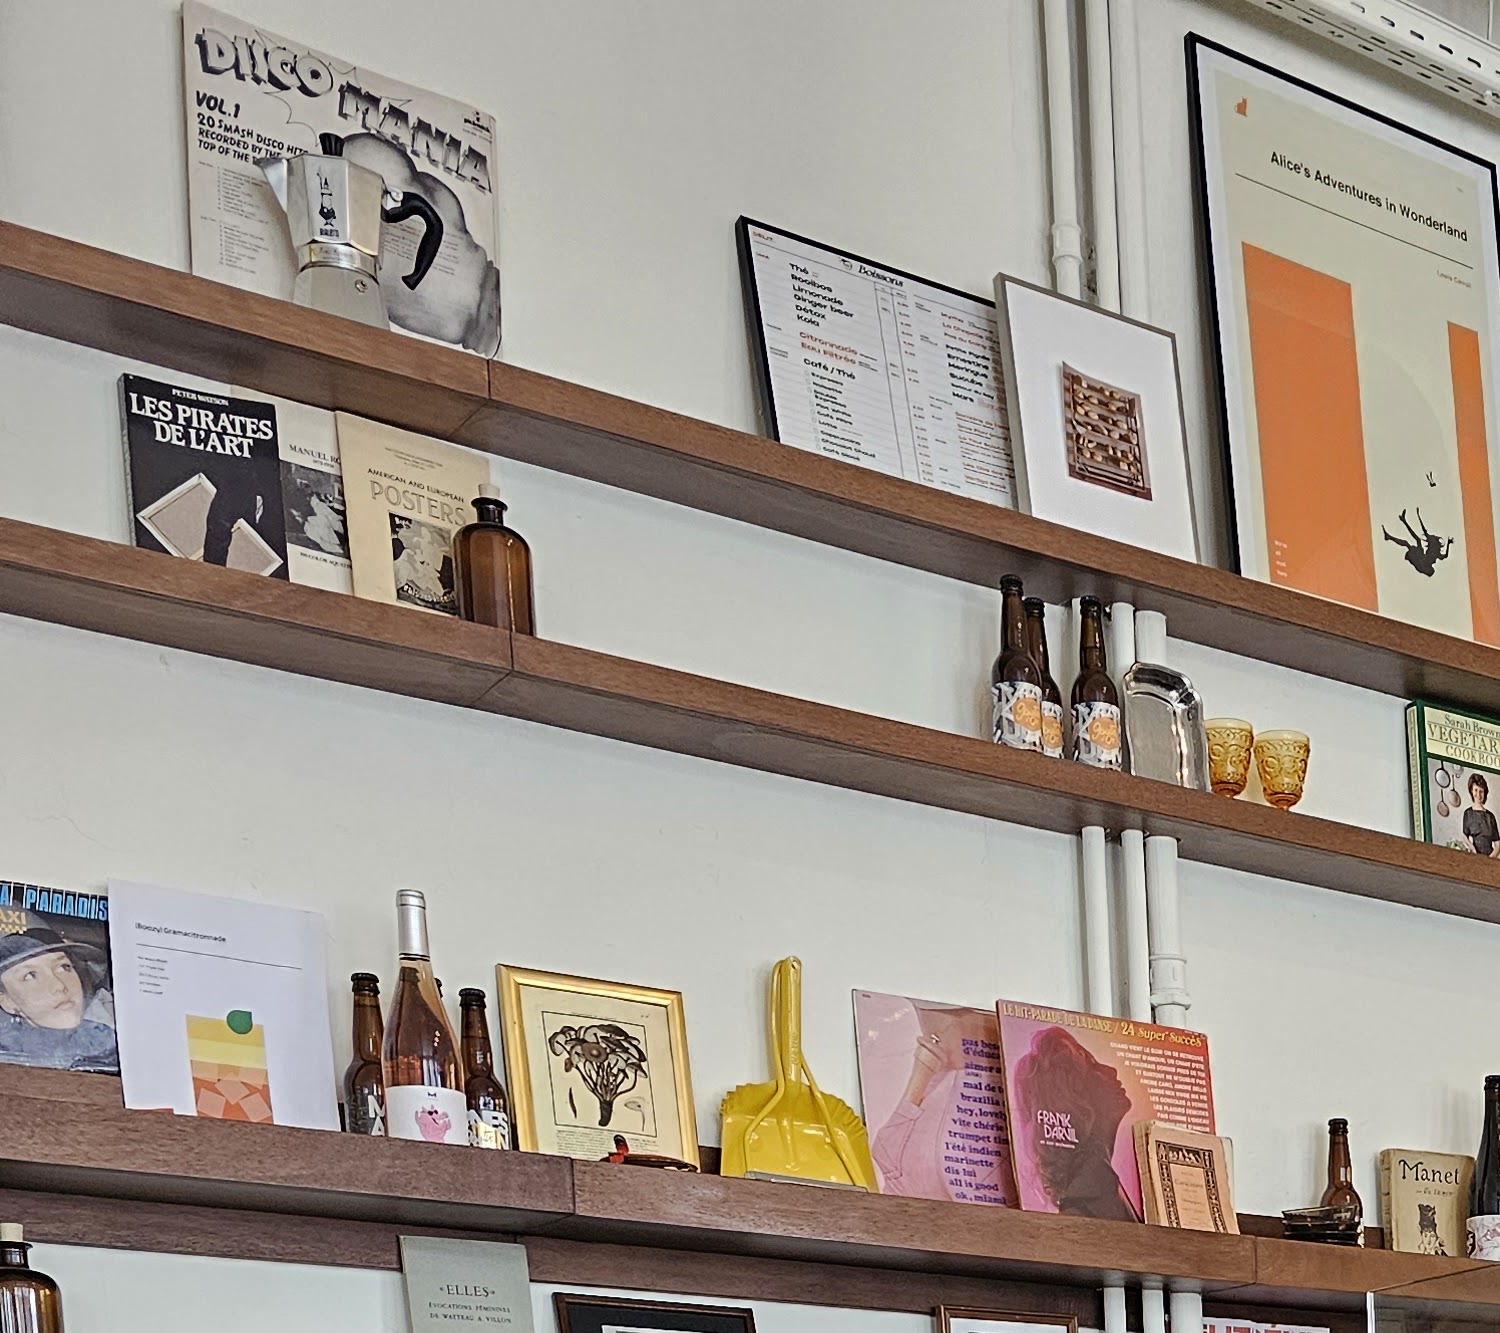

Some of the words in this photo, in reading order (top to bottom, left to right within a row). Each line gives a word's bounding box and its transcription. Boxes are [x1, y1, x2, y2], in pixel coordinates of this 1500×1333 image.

[195, 28, 333, 97] DISCO
[338, 81, 492, 194] MANIA
[196, 91, 240, 118] VOL.1
[197, 112, 215, 128] 20
[218, 120, 253, 139] SMASH
[256, 134, 284, 150] DISCO
[198, 128, 248, 150] RECORDED
[251, 145, 263, 155] BY
[198, 139, 216, 151] TOP
[218, 146, 230, 155] OF
[232, 150, 249, 162] THE
[1271, 152, 1311, 178] Alice's
[1315, 170, 1382, 208] Adventures
[1386, 198, 1397, 213] in
[1400, 204, 1468, 242] Wonderland
[789, 262, 809, 274] Thé
[858, 264, 904, 288] Boissons
[791, 274, 832, 292] Rooibos
[793, 284, 844, 306] Limonade
[794, 294, 827, 310] Ginger
[830, 305, 854, 318] beer
[795, 304, 826, 320] Détox
[797, 314, 820, 327] Kola
[800, 331, 858, 355] Citronnade
[129, 392, 172, 420] LES
[176, 403, 273, 440] PIRATES
[154, 421, 185, 447] DE
[189, 428, 253, 458] L'ART
[289, 444, 329, 462] MANUEL
[368, 467, 406, 484] AMERICAN
[408, 480, 425, 490] AND
[427, 485, 465, 503] EUROPEAN
[369, 480, 466, 526] POSTERS
[1445, 714, 1471, 730] Sarah
[26, 889, 107, 920] PARADIS
[1015, 1005, 1063, 1024] HIT-PARADE
[1169, 1032, 1202, 1047] Succès
[964, 1062, 994, 1073] aimer
[963, 1082, 982, 1090] mal
[984, 1084, 996, 1092] de
[952, 1118, 971, 1127] vite
[973, 1121, 1004, 1131] chérie
[1037, 1110, 1071, 1127] FRANK
[948, 1130, 991, 1143] trumpet
[944, 1155, 994, 1168] marinette
[969, 1145, 1001, 1156] indien
[944, 1166, 959, 1175] dis
[962, 1168, 976, 1177] lui
[1399, 1159, 1459, 1185] Manet
[949, 1179, 962, 1187] all
[964, 1180, 973, 1188] is
[975, 1182, 999, 1191] good
